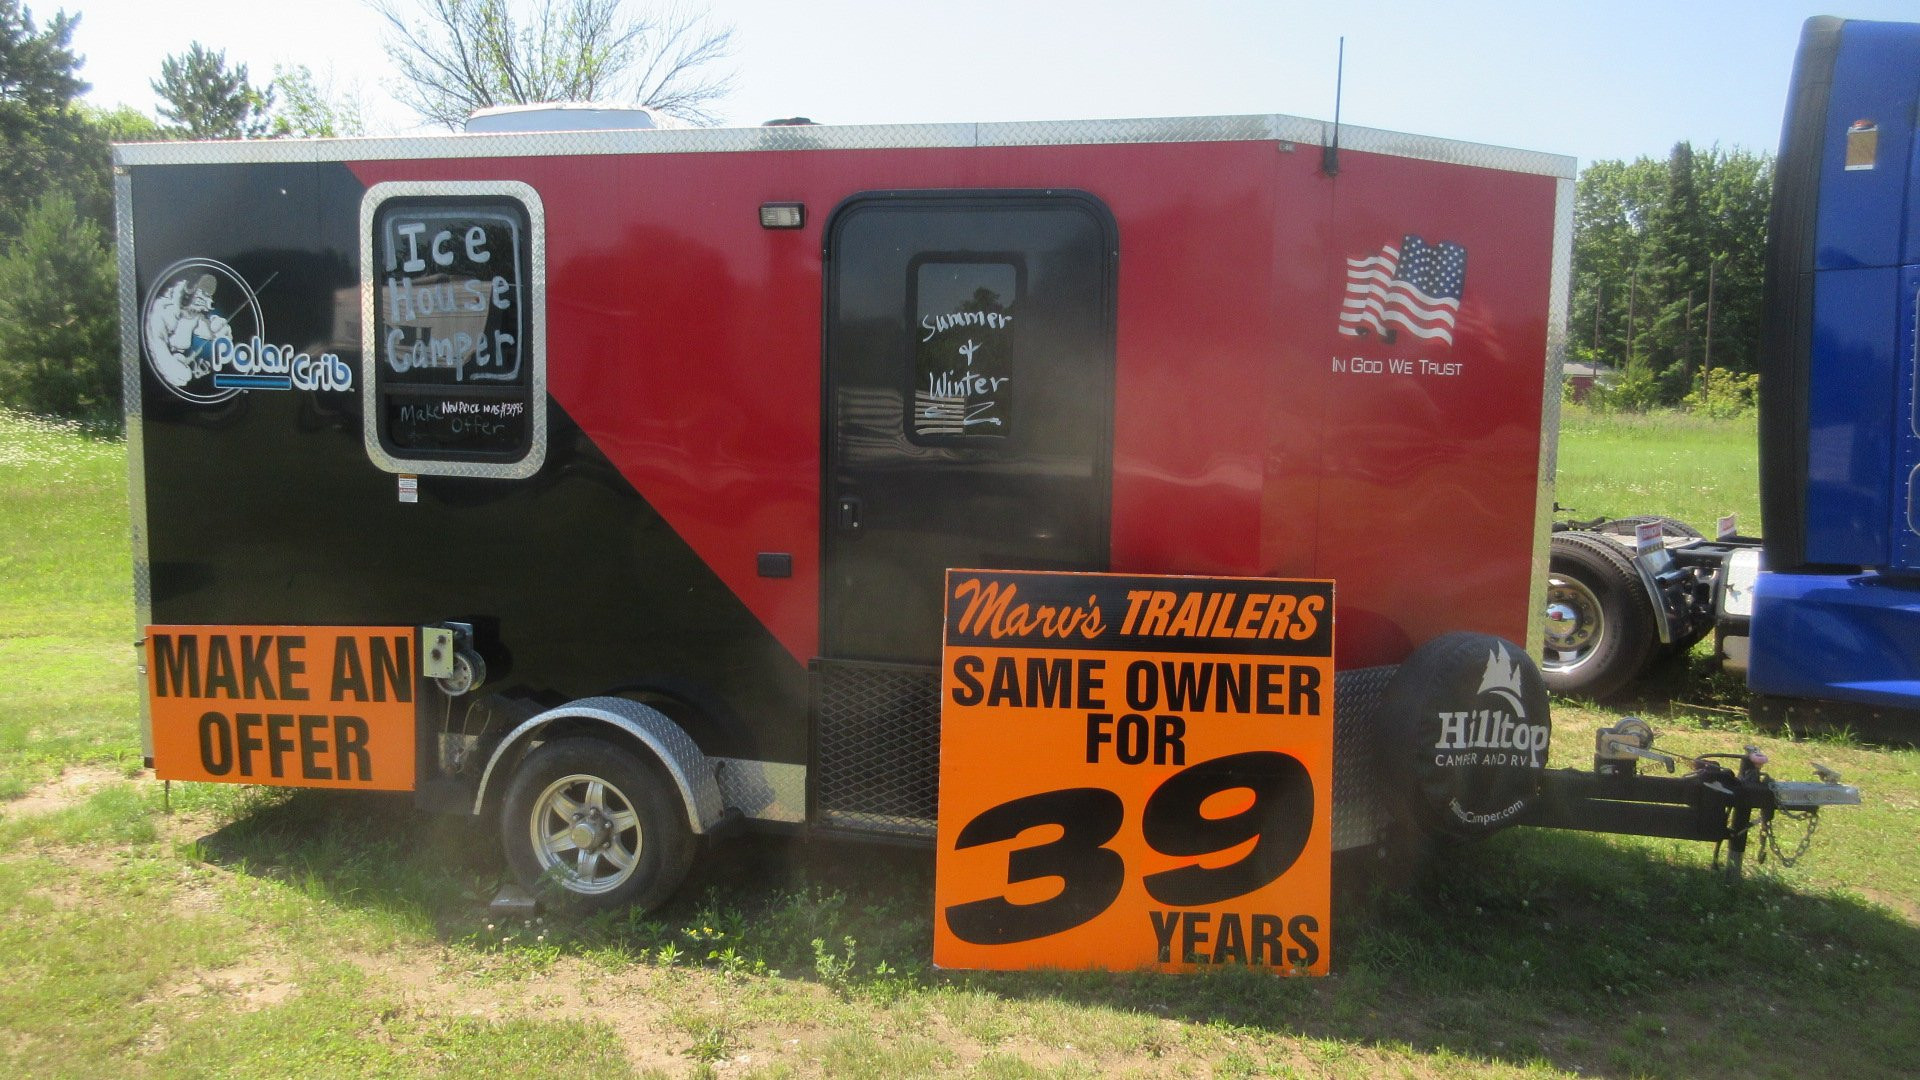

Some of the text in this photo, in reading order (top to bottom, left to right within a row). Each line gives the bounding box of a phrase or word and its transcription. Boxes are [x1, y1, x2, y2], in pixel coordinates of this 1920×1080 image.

[398, 222, 491, 273] Ice
[388, 275, 511, 323] House
[922, 311, 1012, 342] Summer
[387, 328, 515, 382] Camper
[929, 370, 1010, 400] Winter
[401, 405, 444, 425] Make
[954, 578, 1325, 641] Marv's TRAILERS
[153, 634, 413, 703] MAKE AN
[951, 655, 1321, 716] SAME OWNER
[198, 711, 373, 782] OFFER
[1086, 713, 1186, 766] FOR
[1435, 709, 1549, 768] Hilltop
[1435, 752, 1528, 768] CAMPER AND RV
[945, 750, 1315, 945] 39
[1149, 911, 1320, 967] YEARS
